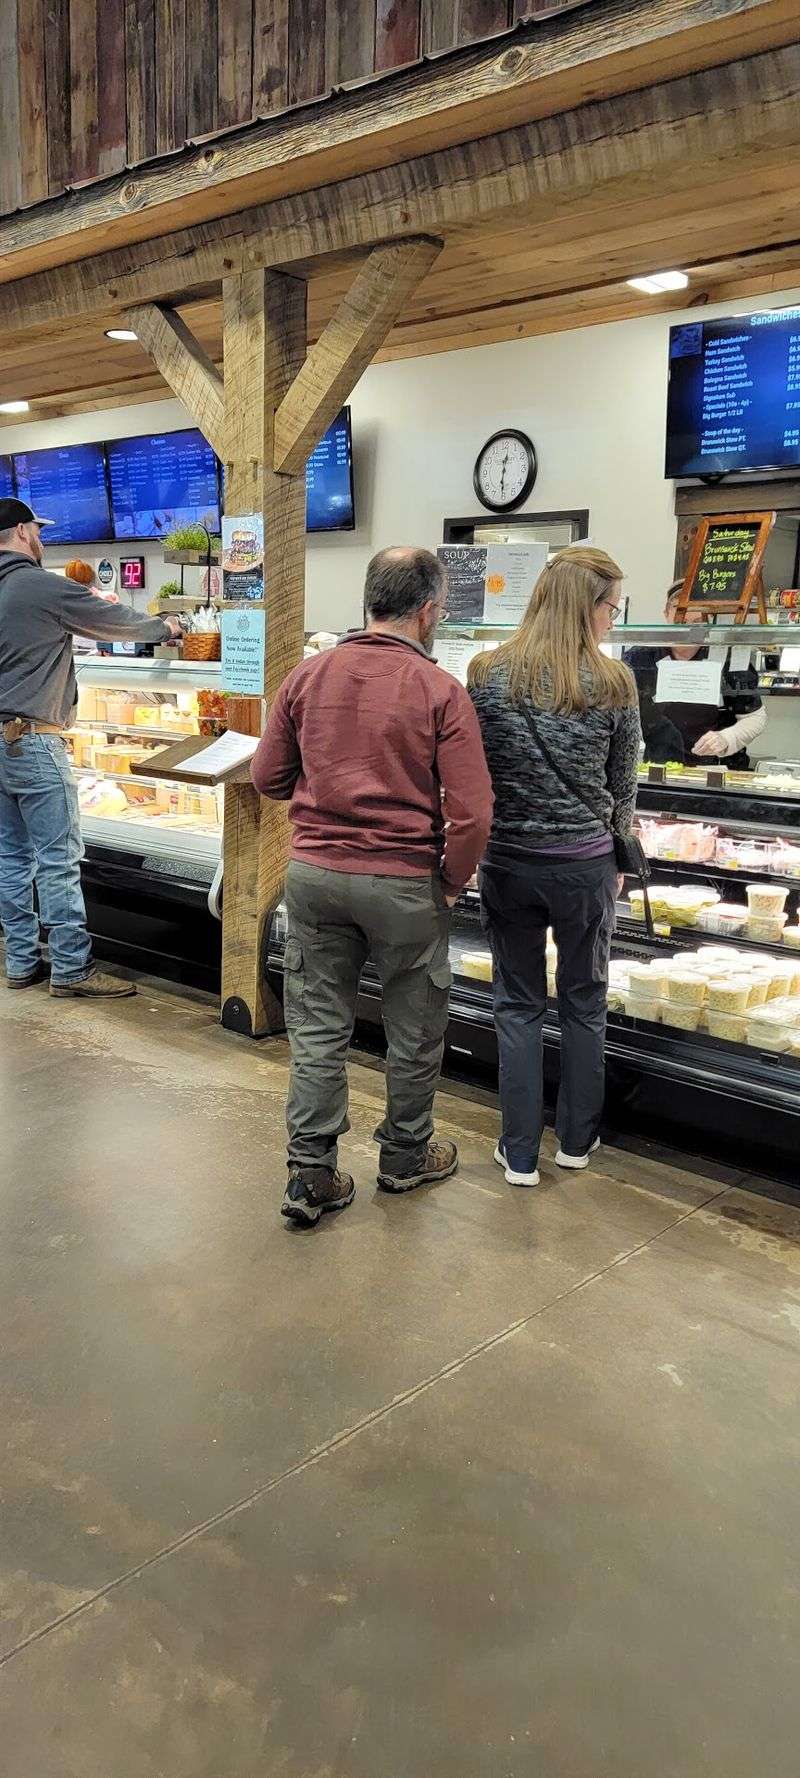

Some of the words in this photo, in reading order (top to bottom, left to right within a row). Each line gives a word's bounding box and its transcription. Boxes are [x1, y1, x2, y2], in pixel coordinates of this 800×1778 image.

[712, 529, 750, 540] Saturday
[444, 551, 469, 560] SOUP
[125, 564, 141, 584] 92
[698, 569, 710, 582] Big
[713, 568, 737, 581] Burgers
